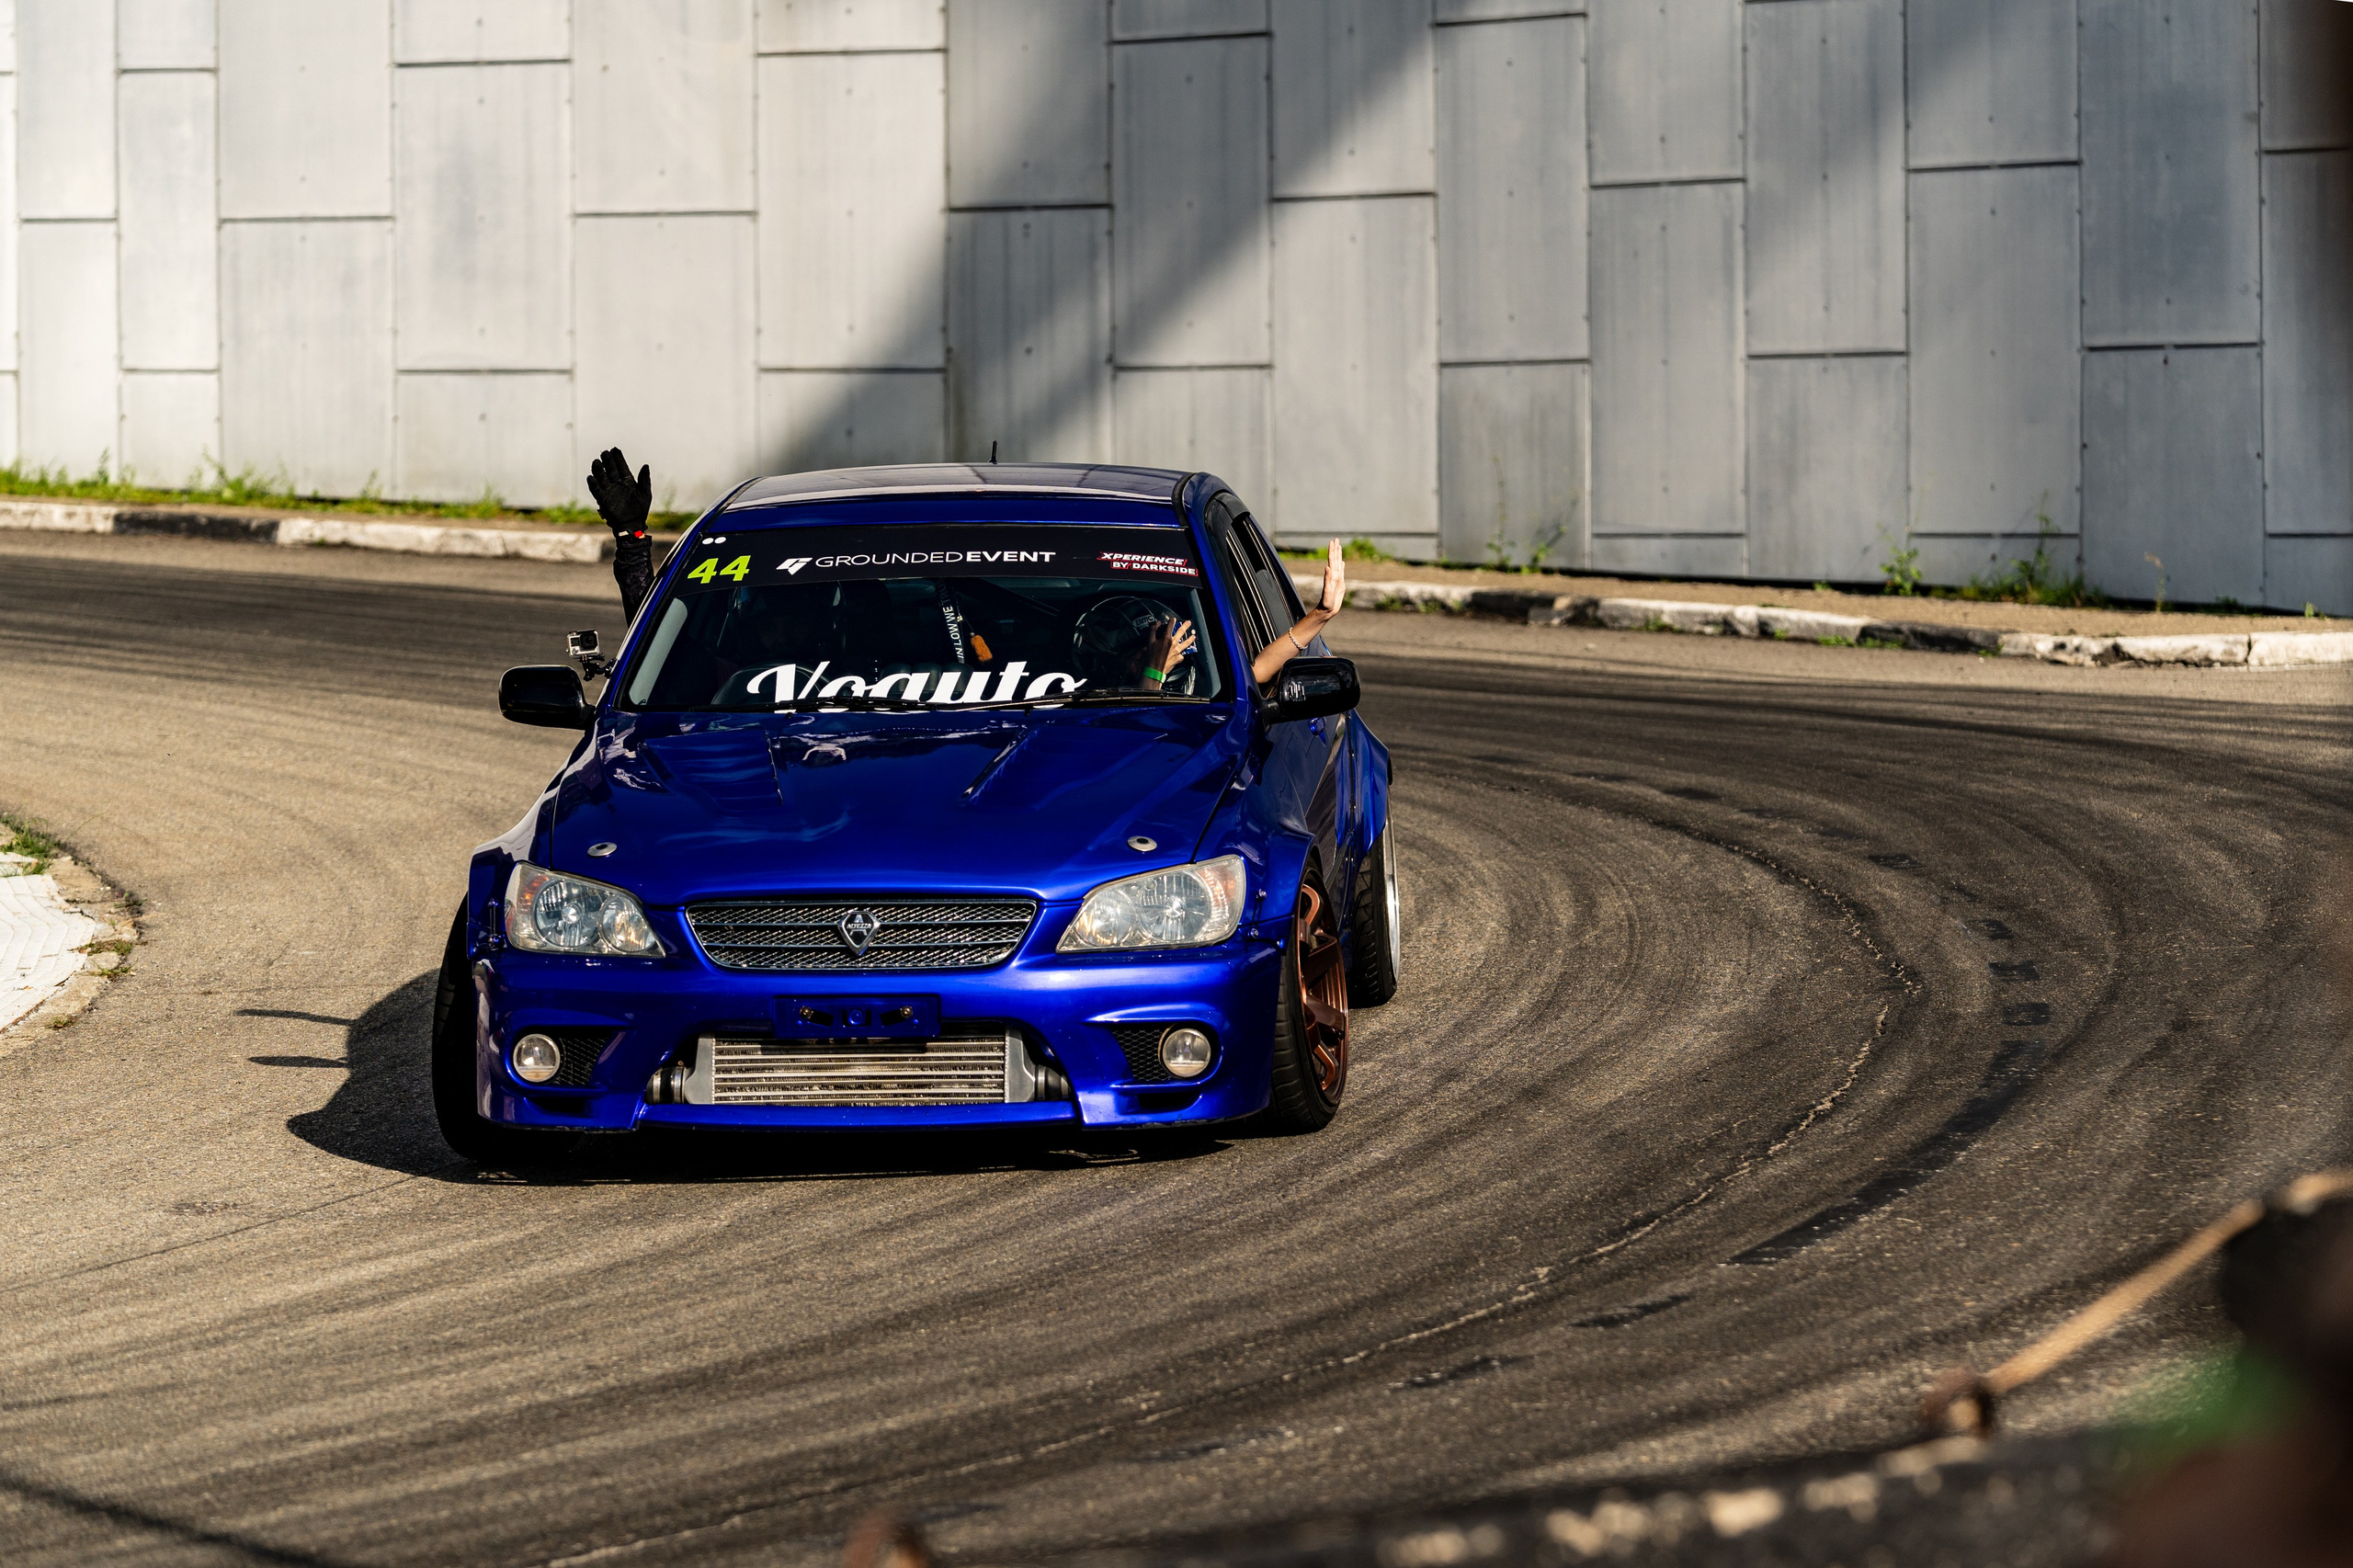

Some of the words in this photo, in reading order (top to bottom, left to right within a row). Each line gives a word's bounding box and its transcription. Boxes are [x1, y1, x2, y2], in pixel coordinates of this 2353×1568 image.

[1100, 552, 1185, 565] XPERIENCE
[687, 554, 752, 585] 44
[1131, 562, 1197, 575] DARKSIDE
[942, 605, 956, 623] WE
[947, 623, 961, 646] LOW
[955, 647, 964, 659] IN
